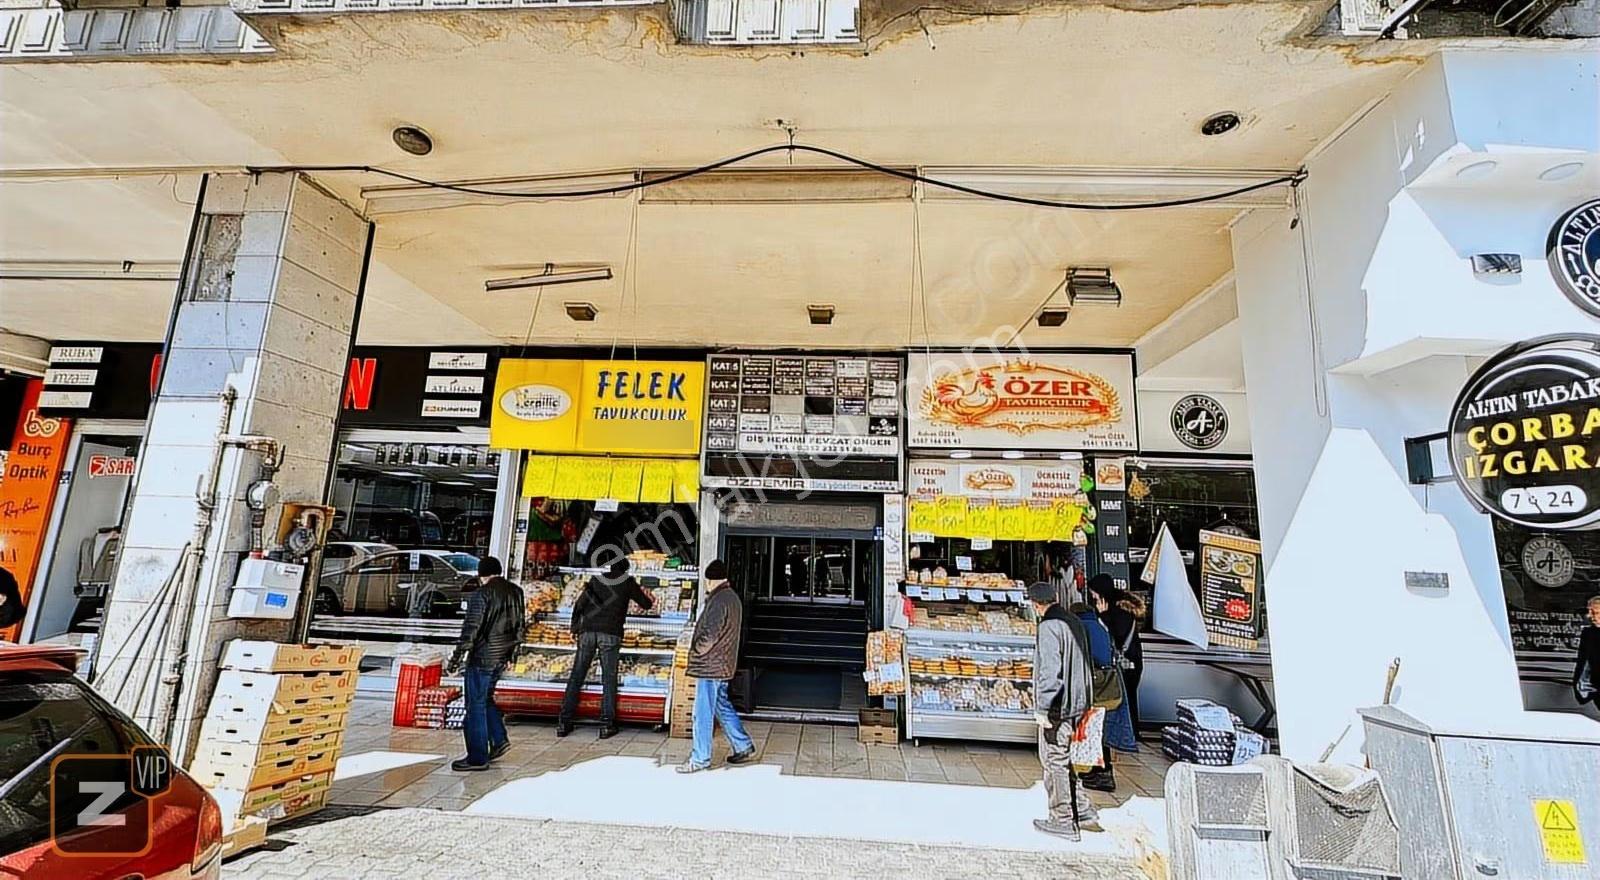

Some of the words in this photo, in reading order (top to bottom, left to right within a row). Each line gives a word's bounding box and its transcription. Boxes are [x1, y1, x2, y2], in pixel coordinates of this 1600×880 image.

[713, 362, 730, 371] KAT
[733, 362, 738, 371] 5
[597, 370, 686, 400] FELEK
[711, 381, 728, 390] KAT
[731, 381, 737, 390] 4
[1003, 376, 1093, 397] ÖZER
[711, 400, 728, 409] KAT
[731, 400, 736, 409] 3
[1006, 398, 1092, 409] TAVUKÇULUK
[1465, 394, 1518, 420] ALTIN
[1523, 377, 1600, 408] TABAK
[709, 418, 726, 427] KAT
[729, 418, 736, 427] 2
[1467, 407, 1600, 454] ÇORBA
[708, 437, 725, 446] KAT
[728, 437, 735, 446] 1
[18, 443, 51, 458] Burç
[1465, 444, 1600, 479] IZGAR
[9, 465, 48, 482] Optik
[1547, 491, 1574, 507] 24
